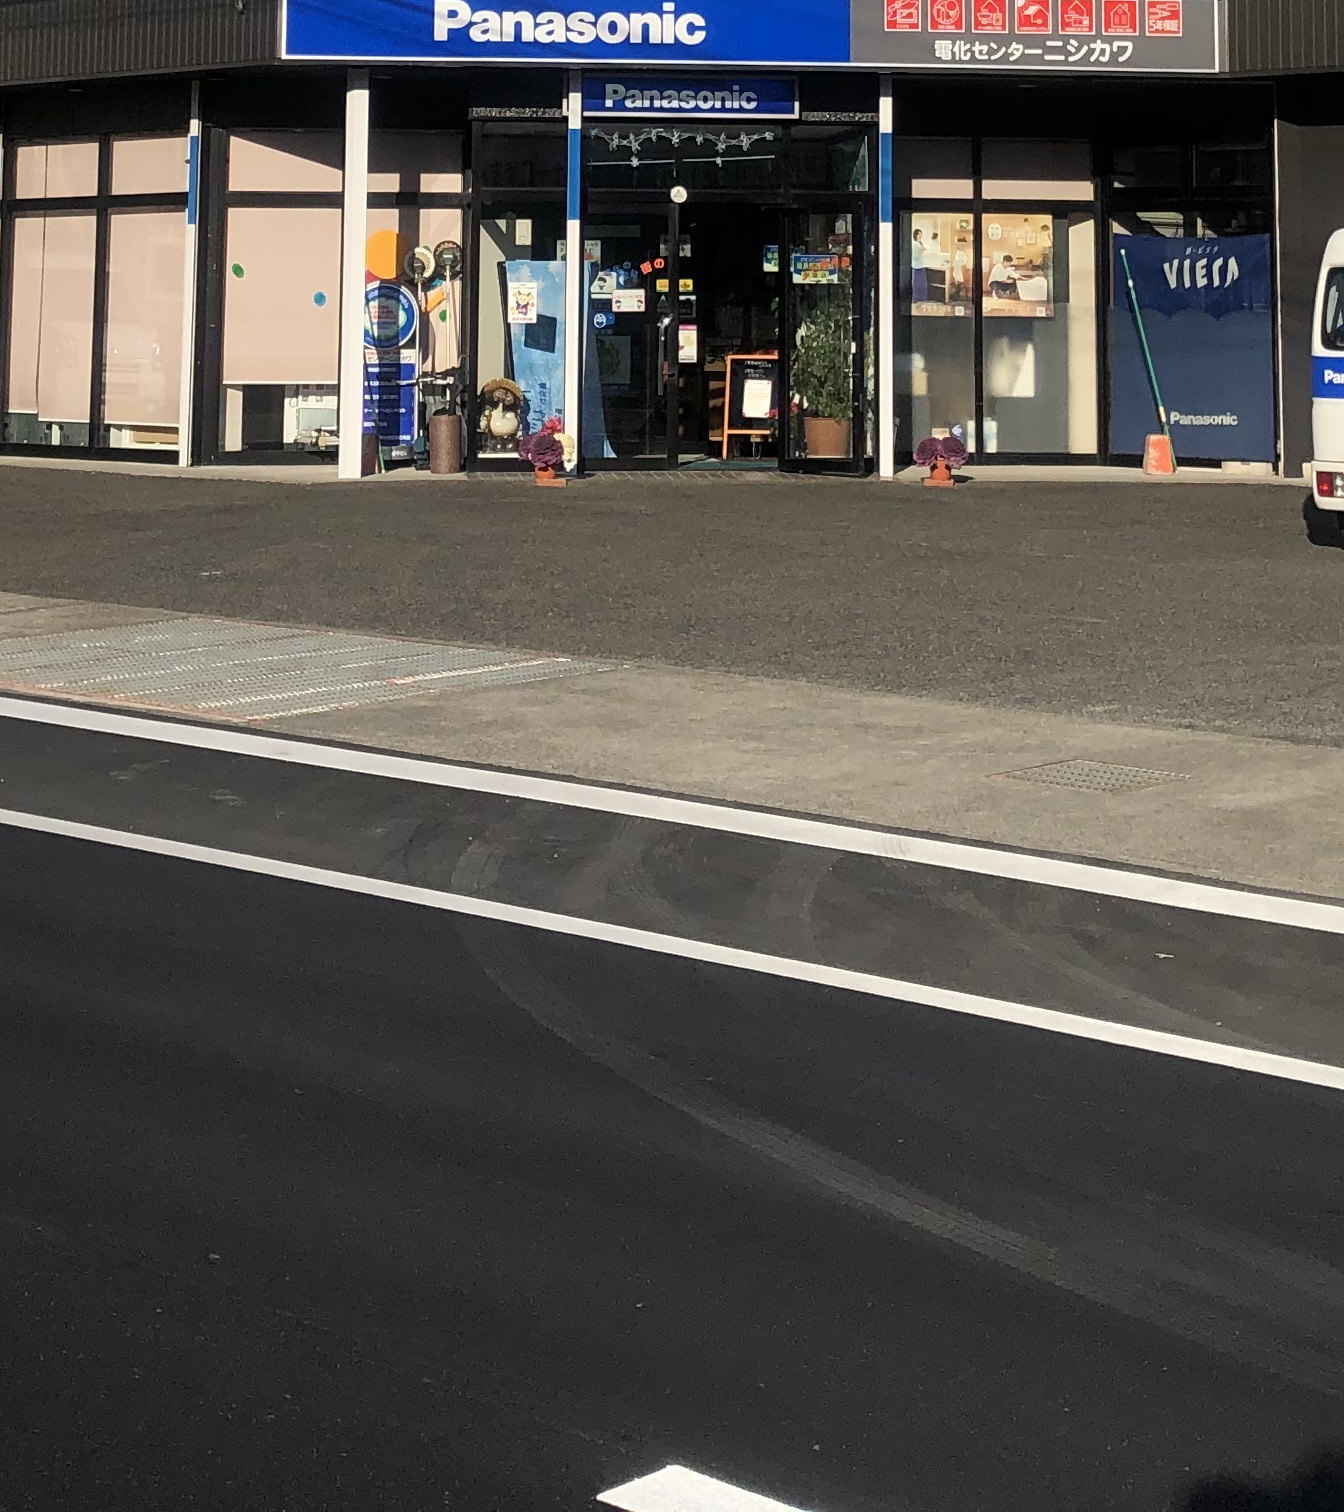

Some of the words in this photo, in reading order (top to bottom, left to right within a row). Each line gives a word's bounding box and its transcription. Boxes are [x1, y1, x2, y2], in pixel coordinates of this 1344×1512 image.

[934, 39, 1134, 63] 電化センターニシカワ
[604, 83, 759, 110] Panasonic
[1169, 412, 1239, 426] Panasonic
